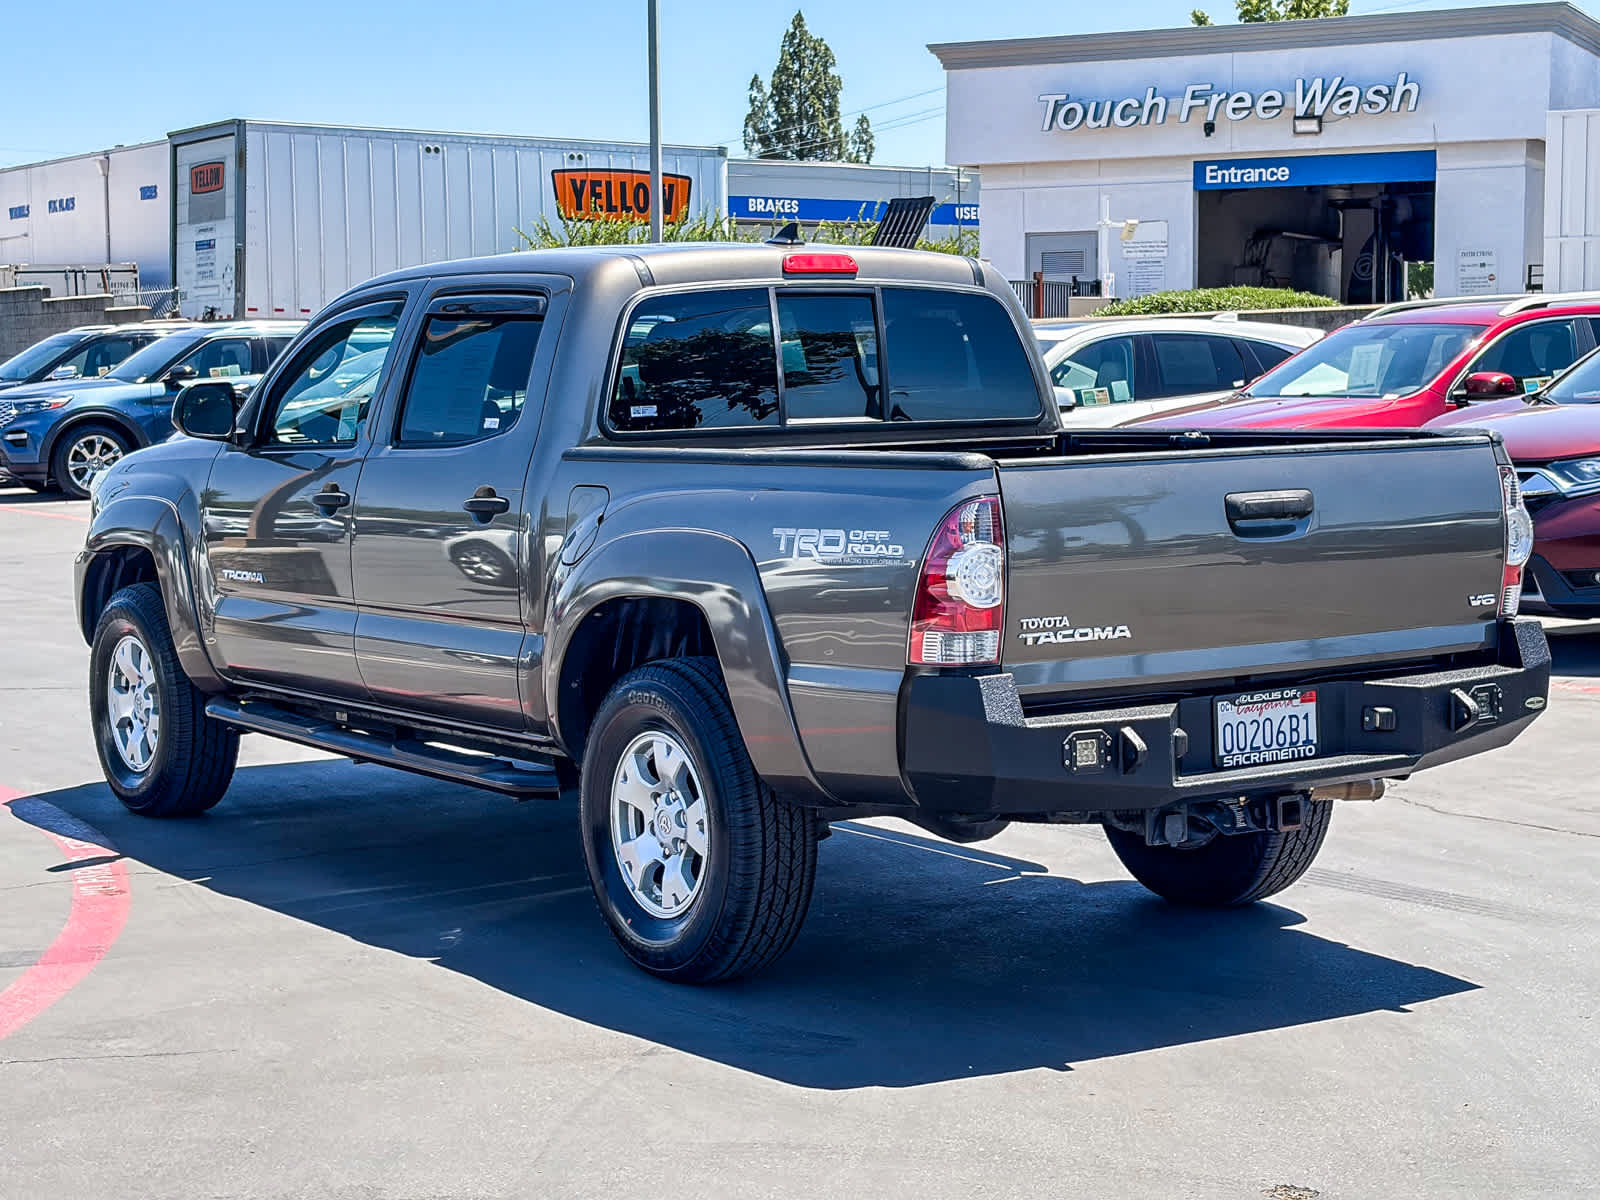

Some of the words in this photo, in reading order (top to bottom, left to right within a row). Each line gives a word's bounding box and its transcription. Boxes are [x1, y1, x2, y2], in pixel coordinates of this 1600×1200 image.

[1038, 87, 1168, 132] Touch
[1178, 83, 1285, 124] Free
[1294, 72, 1421, 118] Wash
[193, 167, 221, 188] YELLOW
[1204, 164, 1291, 185] Entrance
[748, 198, 800, 213] BRAKES
[955, 206, 980, 220] USE
[849, 529, 890, 541] OFF
[772, 527, 847, 560] TRD
[847, 543, 904, 557] ROAD
[222, 569, 265, 583] TACOMA
[1468, 593, 1496, 607] V6
[1020, 616, 1070, 630] TOYOTA
[1018, 625, 1132, 645] TACOMA
[1247, 690, 1282, 702] LEXUS
[1283, 689, 1298, 698] OF
[1222, 712, 1314, 754] 00206B1
[1223, 745, 1316, 767] SACRAMENTO
